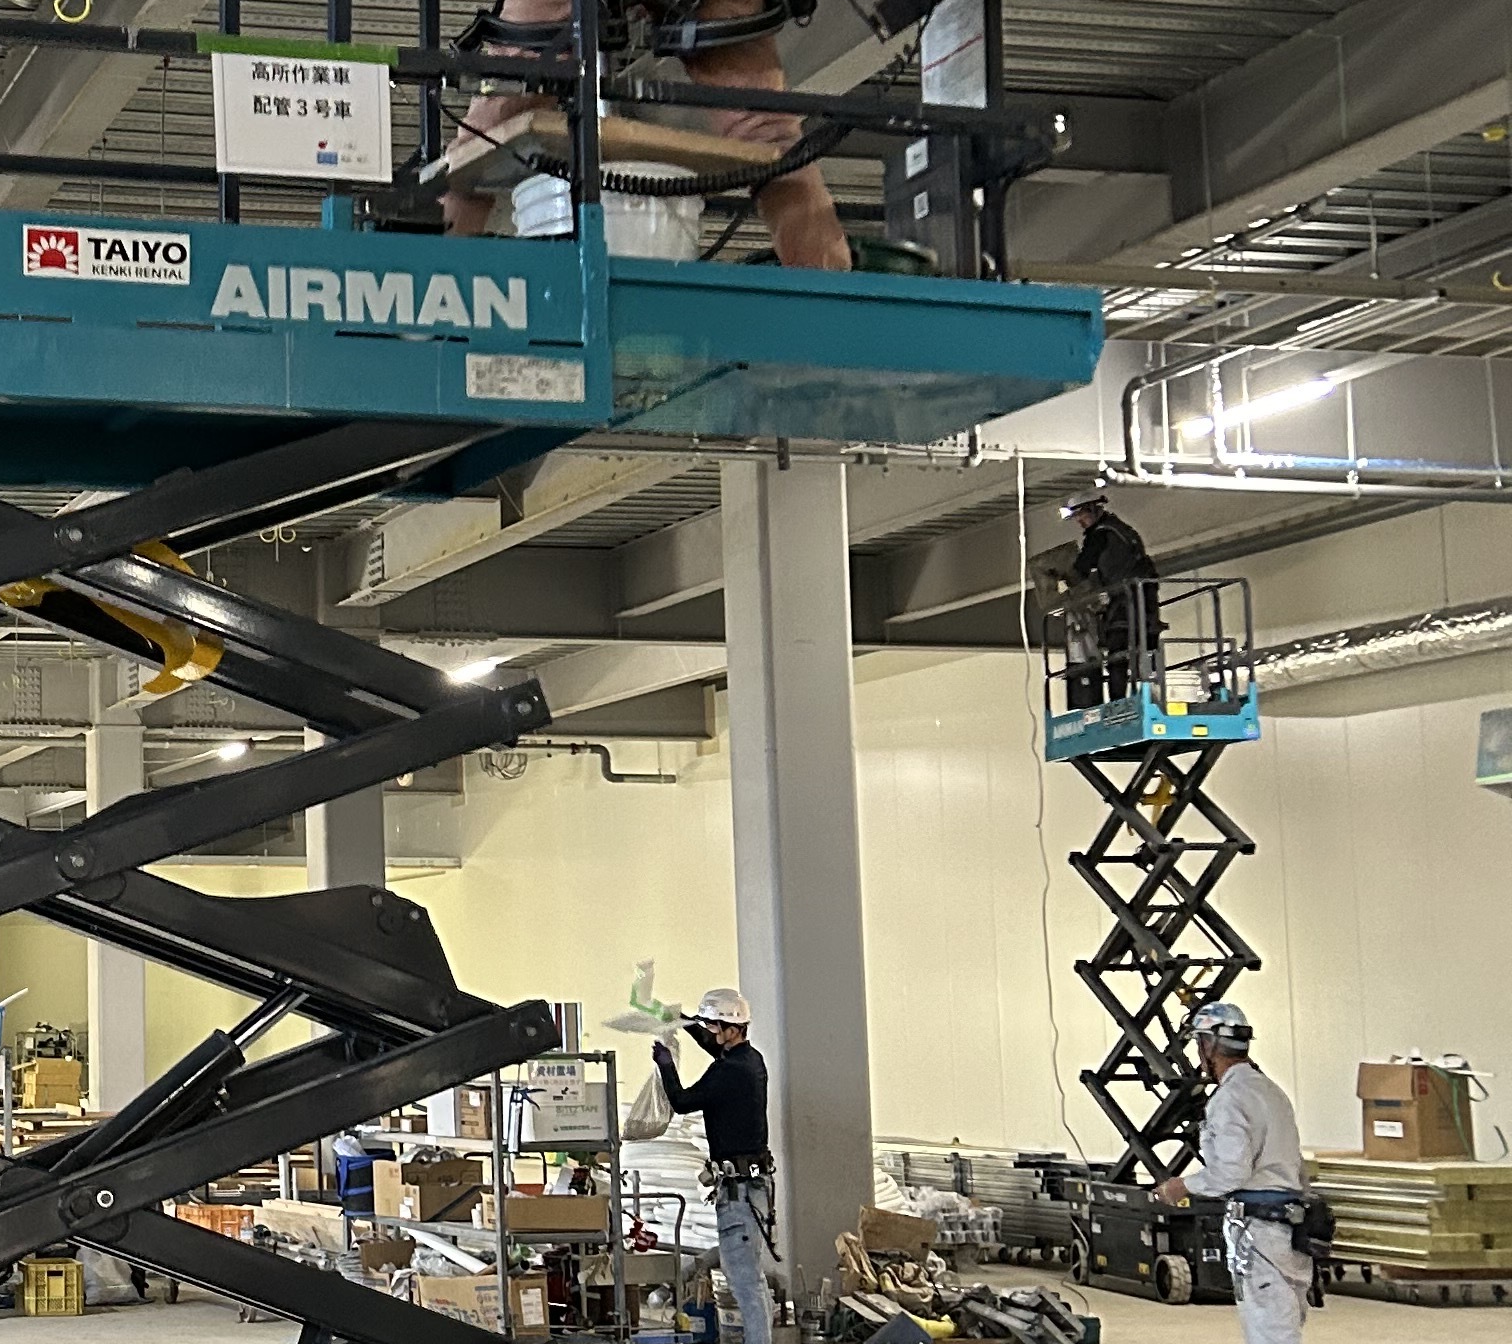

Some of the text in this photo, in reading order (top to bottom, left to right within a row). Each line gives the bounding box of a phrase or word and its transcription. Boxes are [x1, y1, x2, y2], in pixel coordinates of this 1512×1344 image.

[251, 61, 351, 85] 高所作業車
[253, 94, 352, 120] 配管3号車
[87, 237, 188, 265] TAIYO
[92, 264, 185, 280] KENKI RENTAL
[210, 263, 528, 330] AIRMAN
